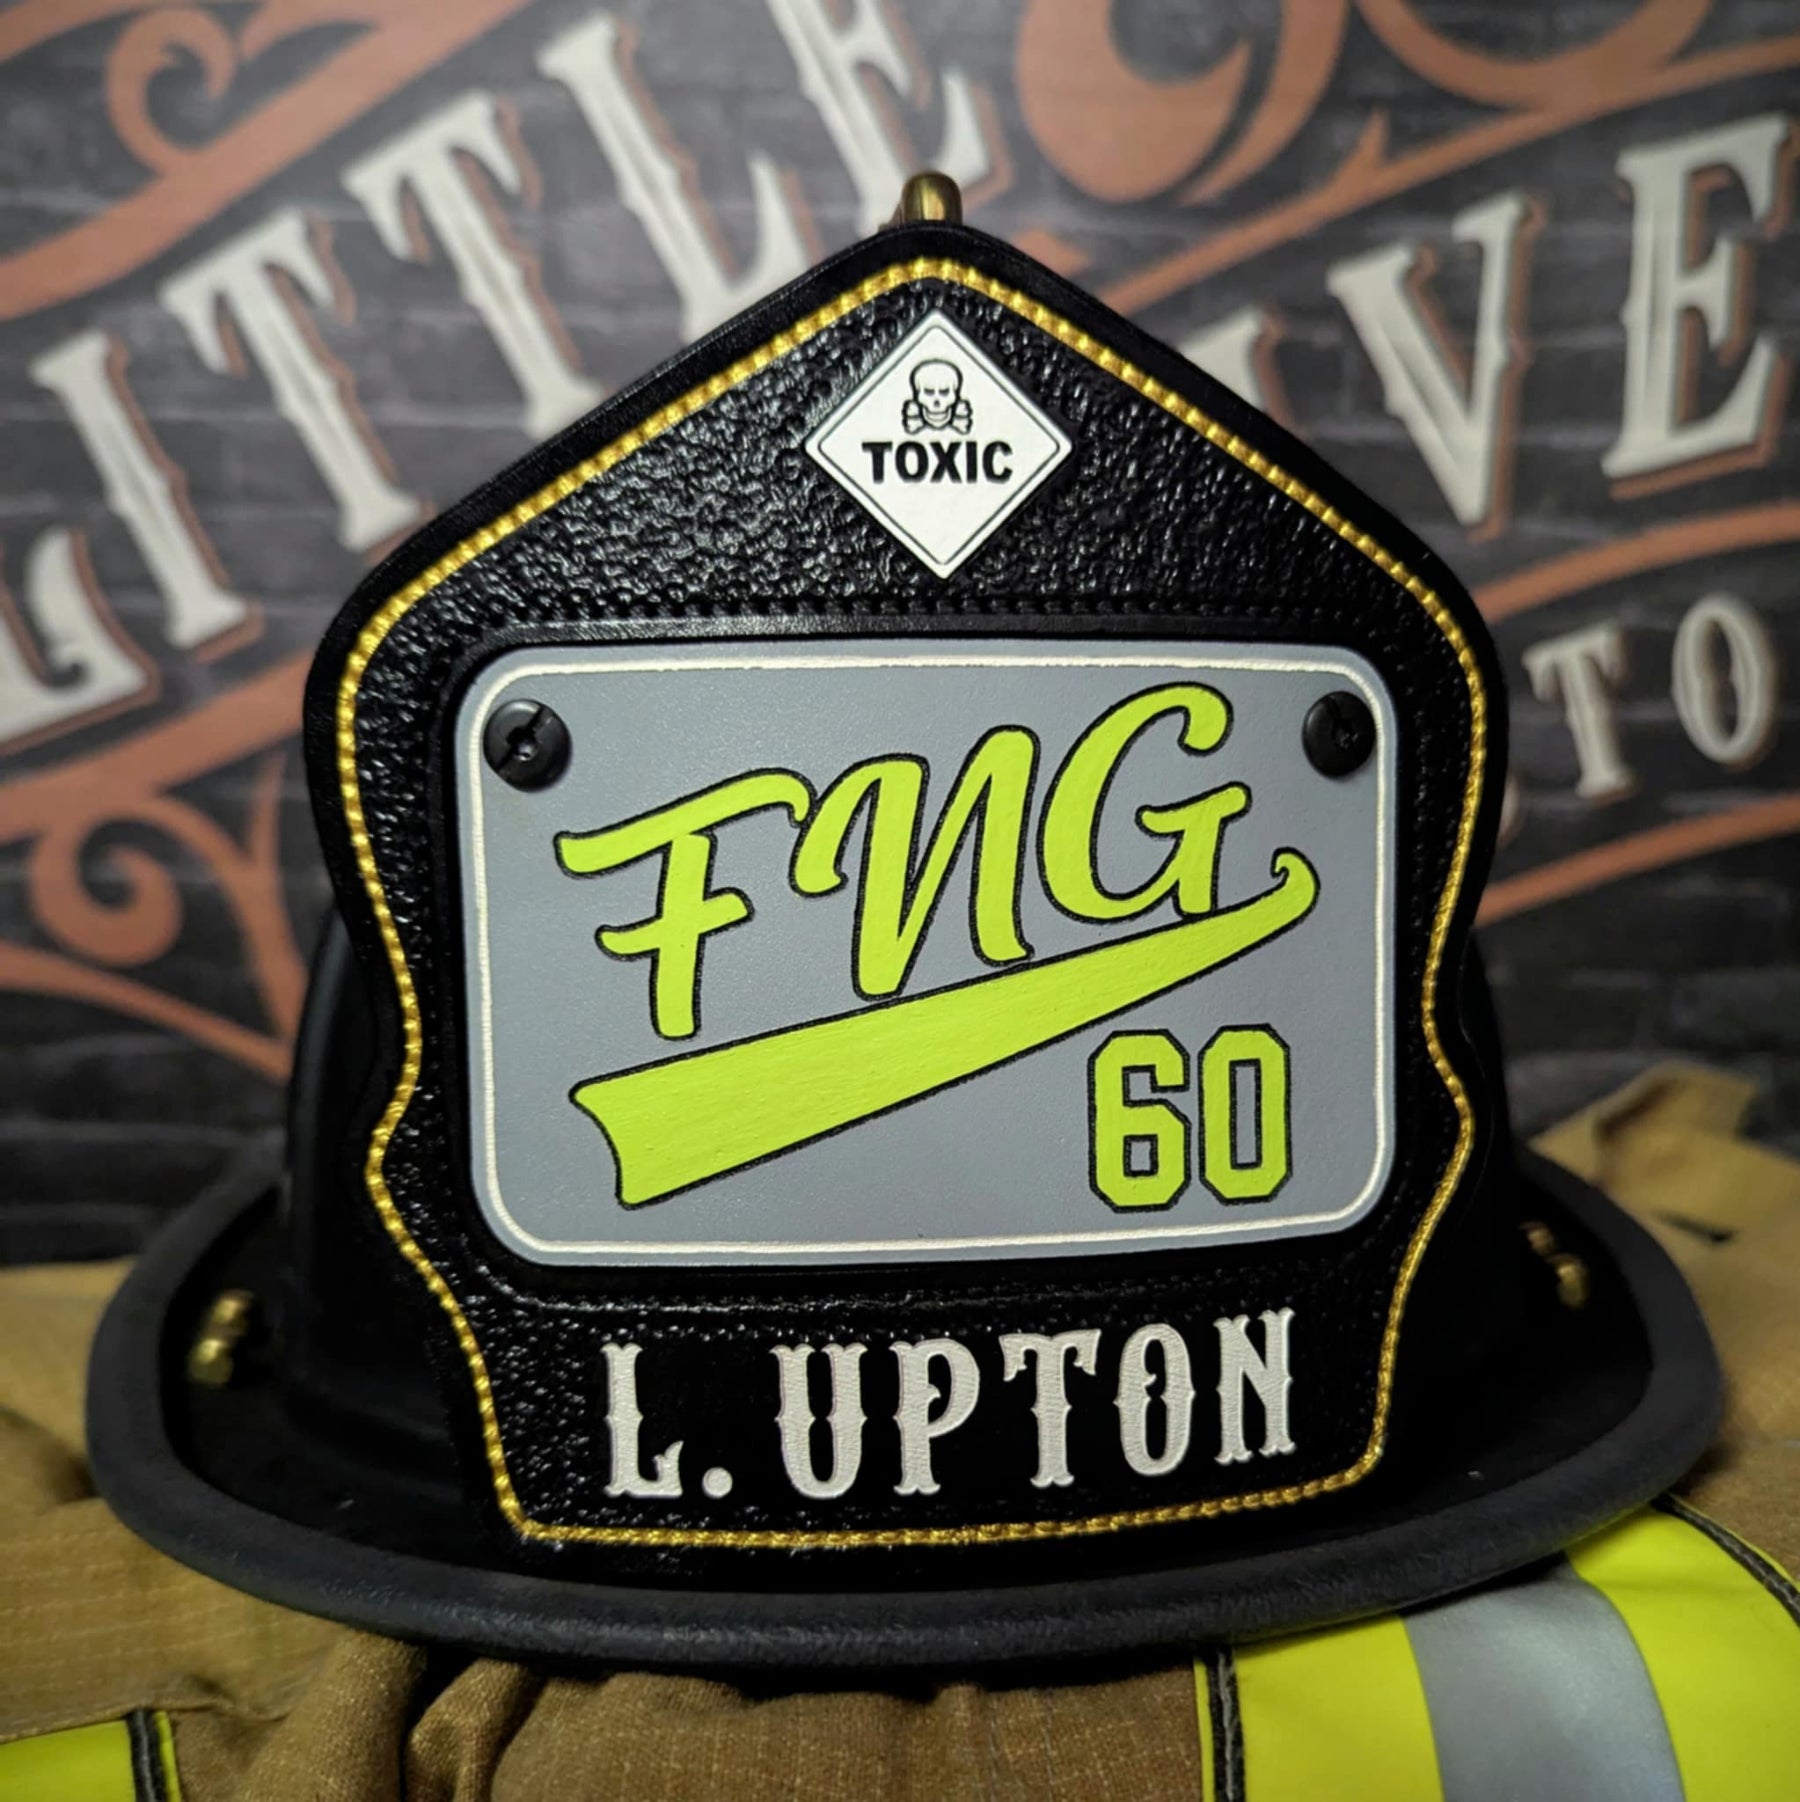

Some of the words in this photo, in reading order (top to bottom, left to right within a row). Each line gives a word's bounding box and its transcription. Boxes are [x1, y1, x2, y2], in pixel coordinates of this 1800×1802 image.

[861, 440, 1014, 485] TOXIC
[553, 681, 1253, 1041] FNG
[1087, 1023, 1293, 1213] 60
[600, 1341, 734, 1498] L.
[769, 1306, 1297, 1499] UPTON
